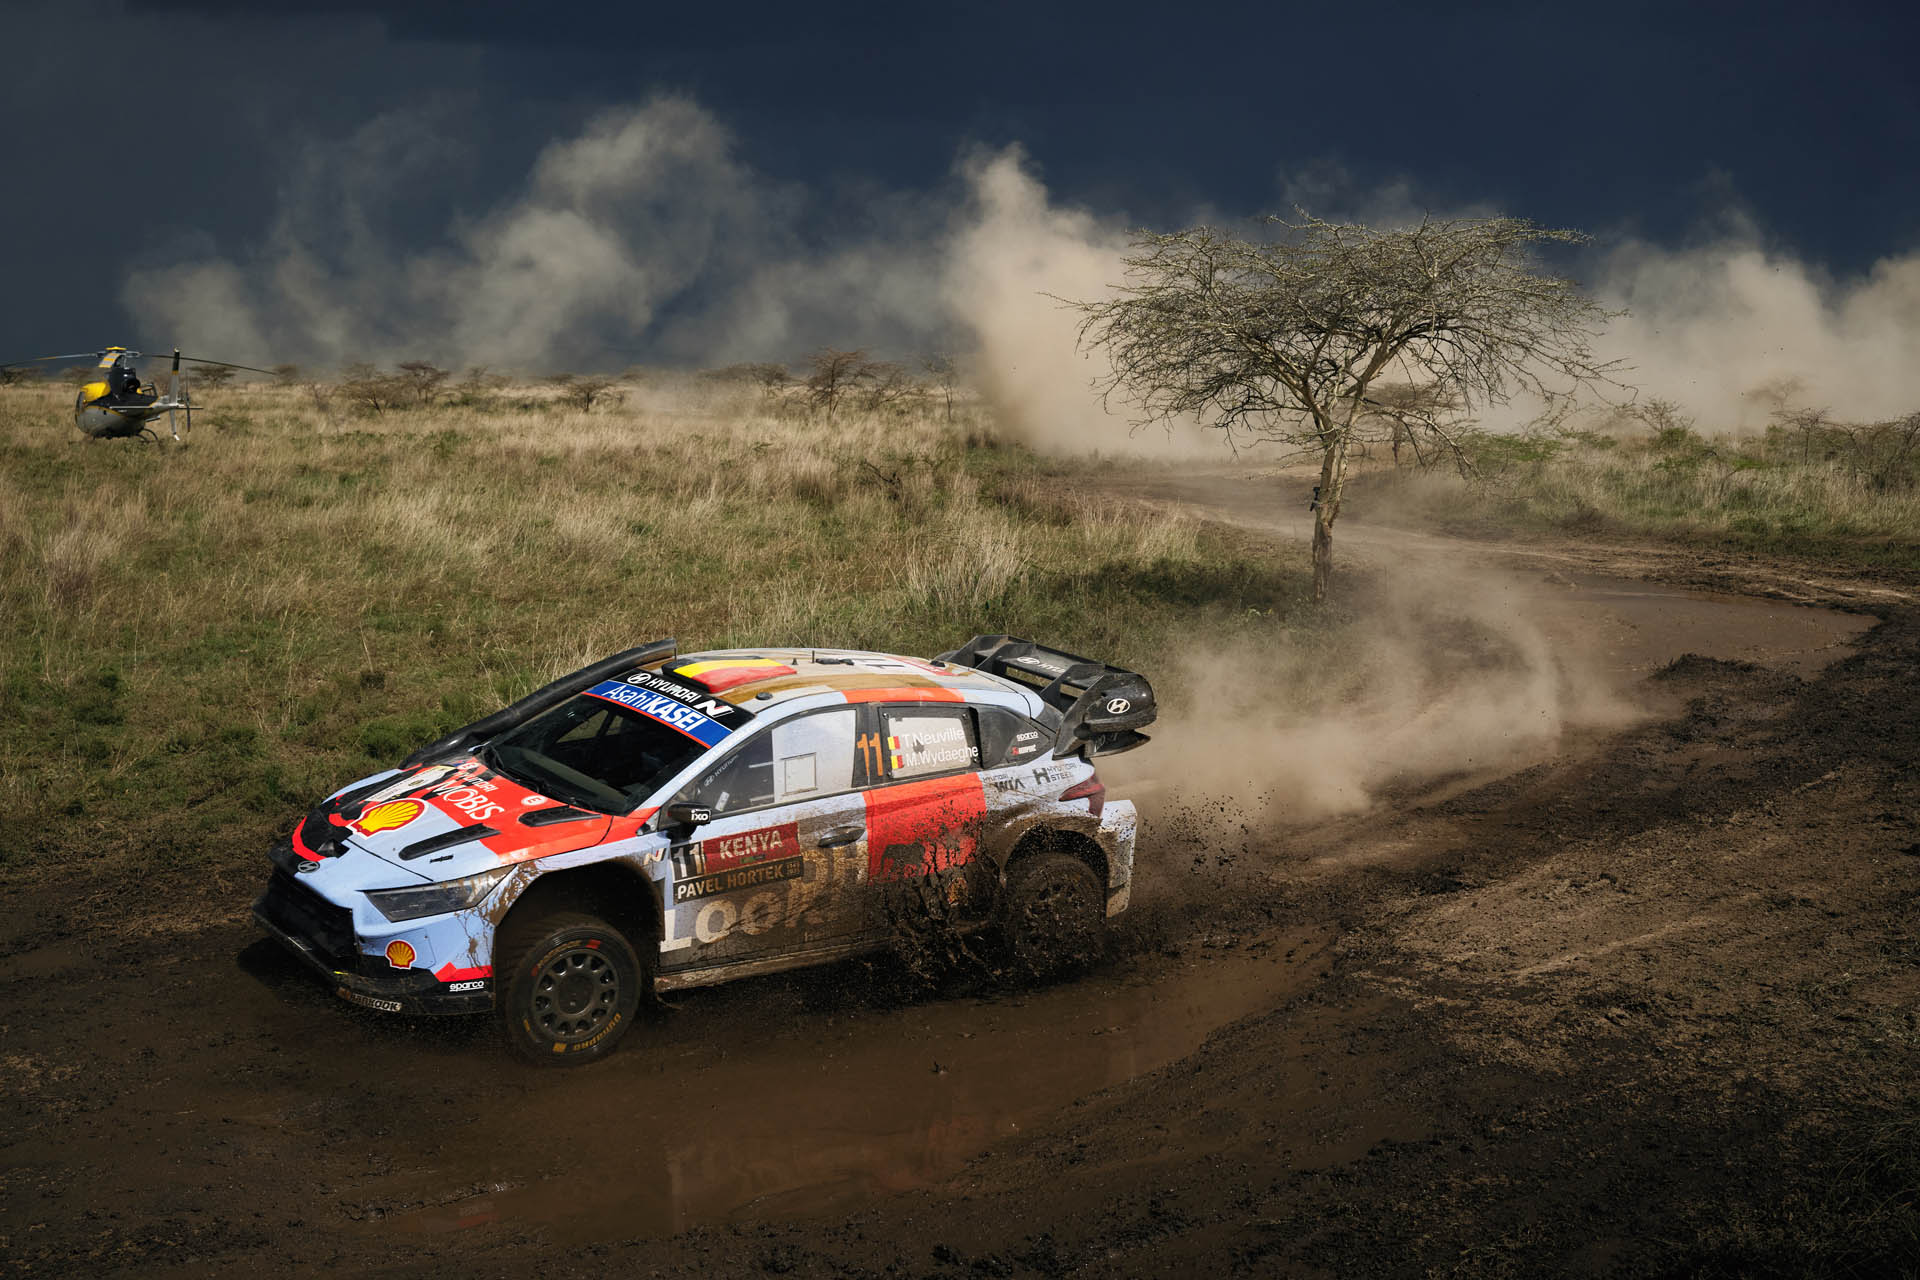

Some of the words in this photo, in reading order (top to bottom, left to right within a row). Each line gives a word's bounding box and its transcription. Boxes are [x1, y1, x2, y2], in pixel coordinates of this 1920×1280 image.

[645, 677, 702, 703] HYUNDAI
[602, 683, 708, 732] AsahiKASEI
[902, 728, 965, 748] T.Neuville
[857, 732, 883, 776] 11
[906, 746, 979, 768] M.Wydaeghe
[432, 780, 504, 820] MOBIS
[691, 810, 709, 821] ixo
[719, 830, 783, 860] KENYA
[673, 843, 703, 878] 11
[677, 881, 722, 900] PAVEL
[728, 863, 785, 889] HORTEK
[449, 981, 485, 992] sparco
